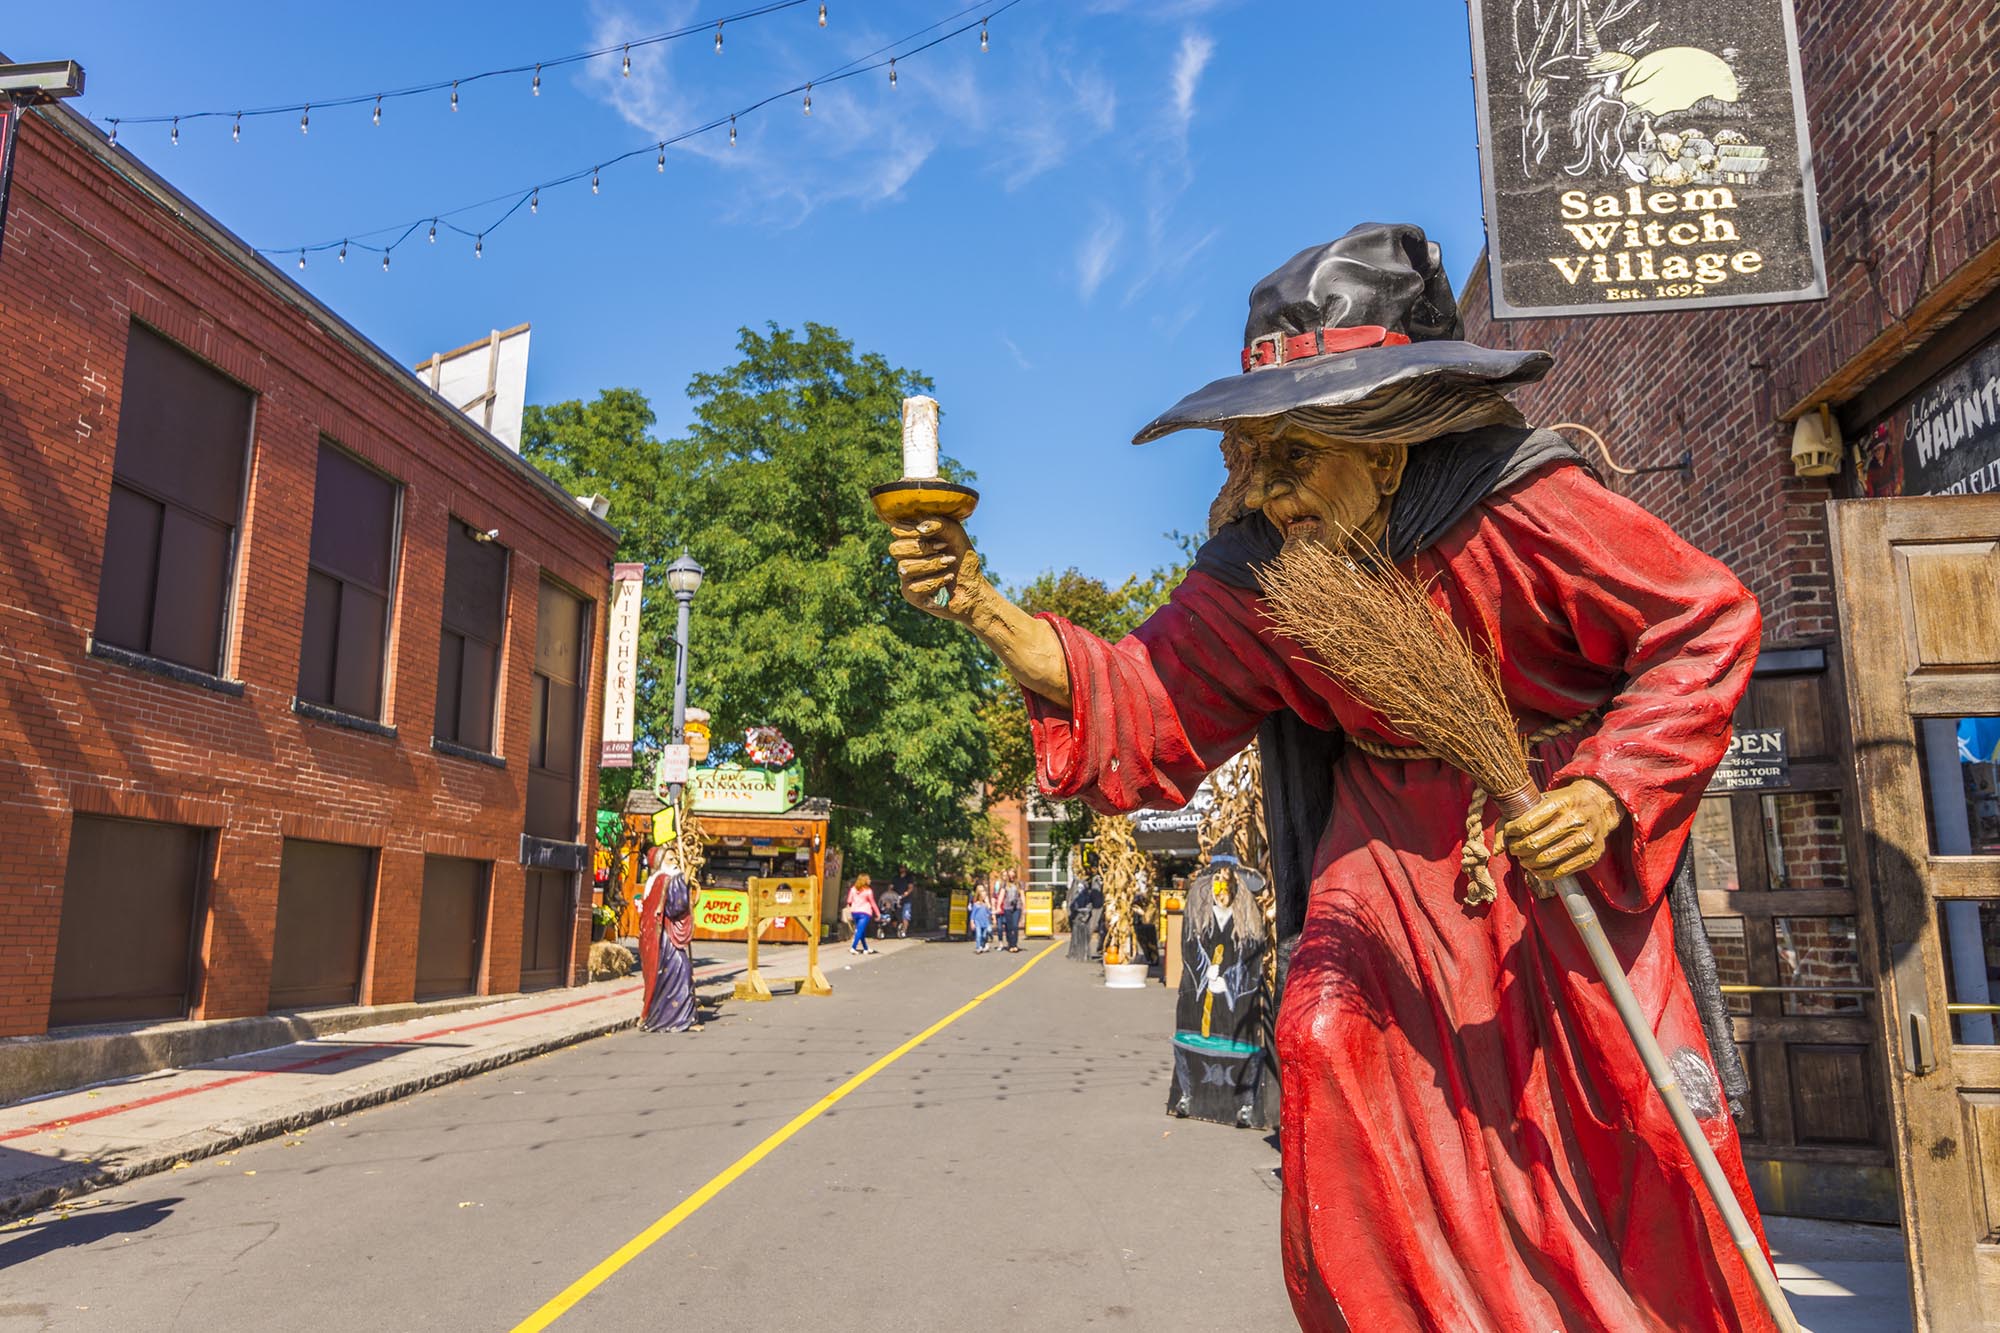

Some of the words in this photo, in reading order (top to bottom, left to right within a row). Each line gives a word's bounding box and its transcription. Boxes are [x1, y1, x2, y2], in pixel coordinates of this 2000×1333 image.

[1561, 186, 1738, 219] Salem
[1563, 212, 1740, 251] Witch
[1549, 250, 1763, 285] Village
[1606, 287, 1646, 300] Est.
[1656, 284, 1705, 297] 1692
[1904, 385, 1948, 441] Salem's
[614, 585, 635, 735] WITCHCRAFT
[1725, 733, 1782, 755] PEN
[1727, 777, 1764, 787] INSIDE
[1750, 767, 1781, 777] TOUR
[704, 900, 742, 912] APPLE
[703, 912, 739, 925] CRISP
